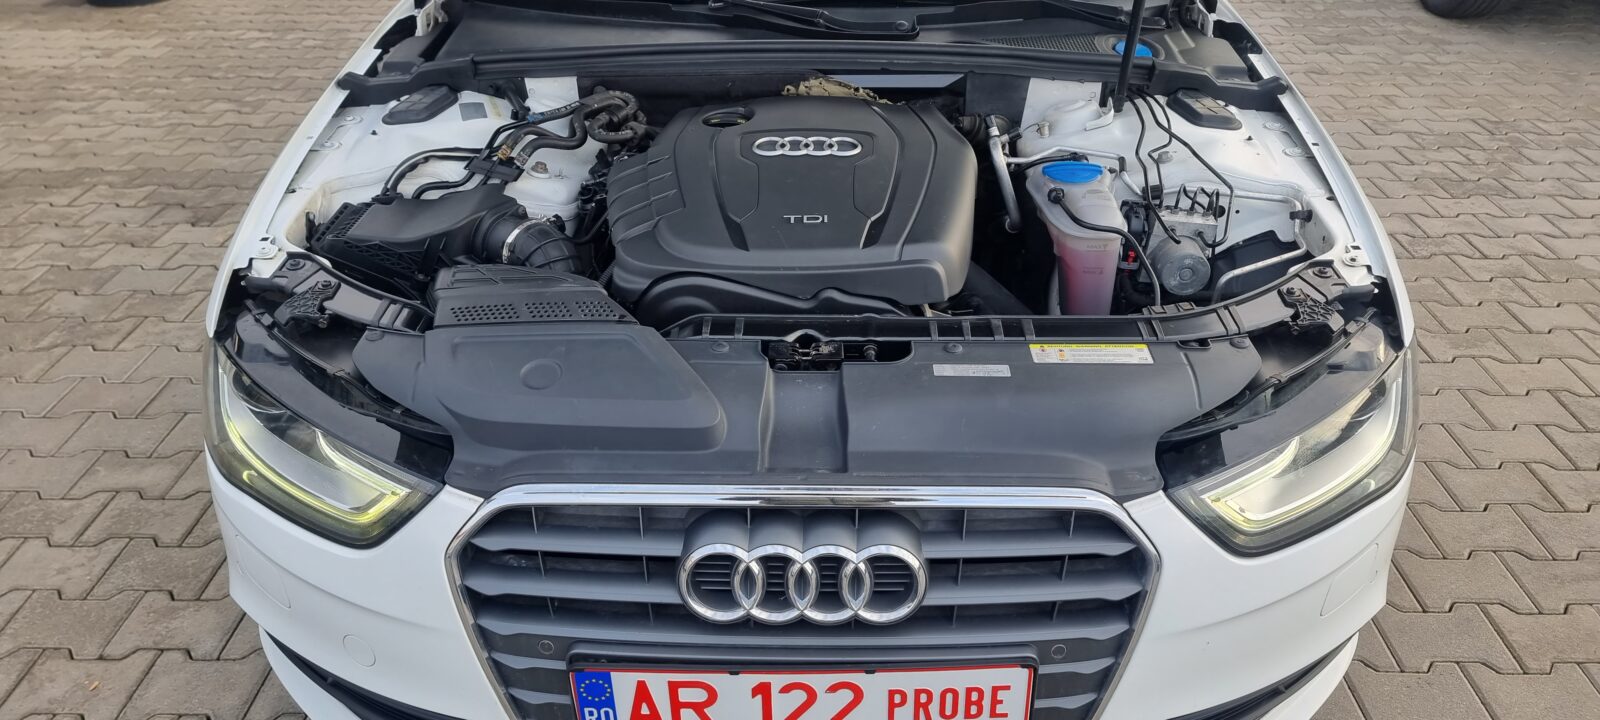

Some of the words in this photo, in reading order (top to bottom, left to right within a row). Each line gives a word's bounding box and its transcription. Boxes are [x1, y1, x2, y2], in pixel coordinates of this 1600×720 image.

[783, 214, 828, 224] TDI
[629, 679, 718, 720] AR
[751, 681, 864, 720] 122
[886, 684, 1011, 720] PROBE
